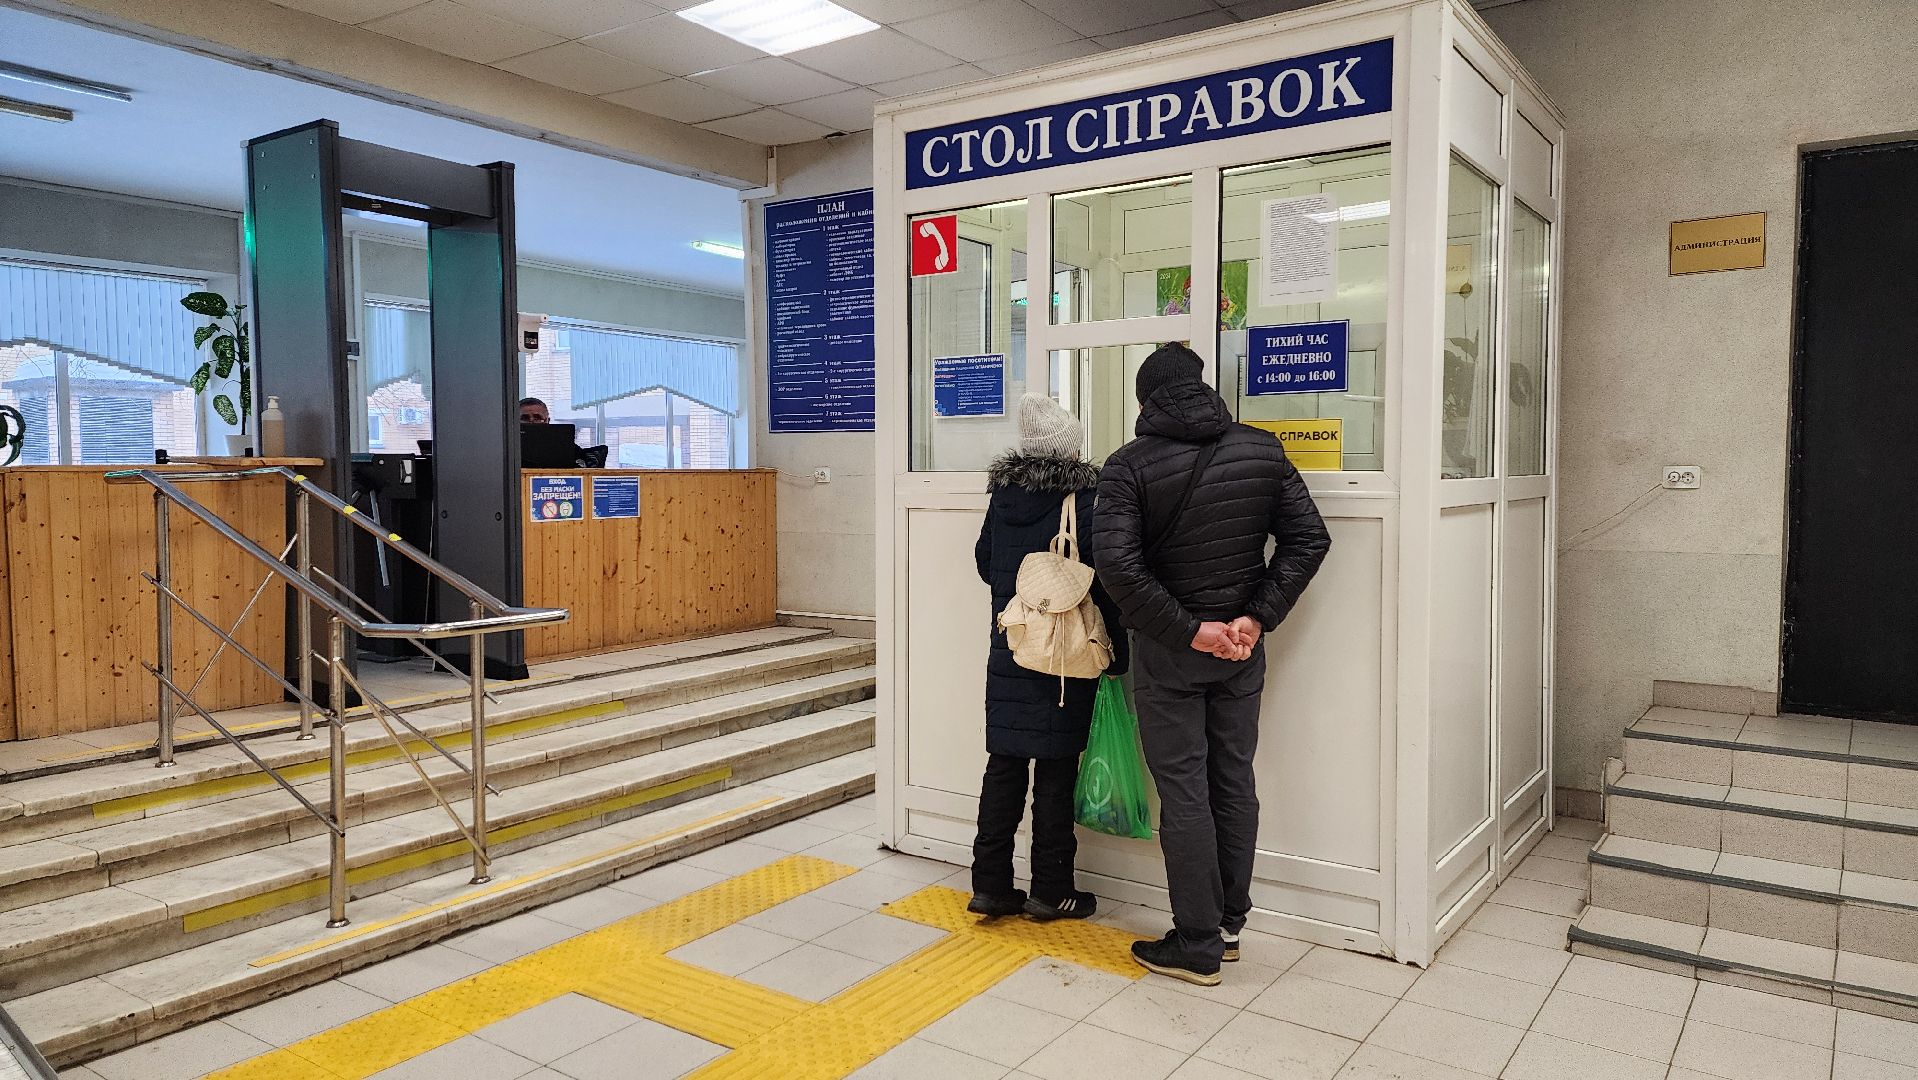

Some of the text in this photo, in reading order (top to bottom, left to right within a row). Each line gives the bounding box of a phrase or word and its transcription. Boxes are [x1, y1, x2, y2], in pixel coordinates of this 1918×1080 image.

[922, 56, 1366, 178] СТОЛ СПРАВОК
[817, 201, 845, 214] ПЛАН
[818, 211, 850, 222] отделений
[1674, 235, 1762, 252] АДМИНИСТРАЦИЯ
[1265, 333, 1329, 348] ТИХИЙ ЧАС
[1261, 351, 1332, 366] ЕЖЕДНЕВНО
[1257, 370, 1336, 384] с 14:00 до 16:00
[1279, 430, 1338, 441] СПРАВОК
[548, 478, 567, 486] ВХОД
[532, 491, 582, 501] ЗАПРЕЩЕН!
